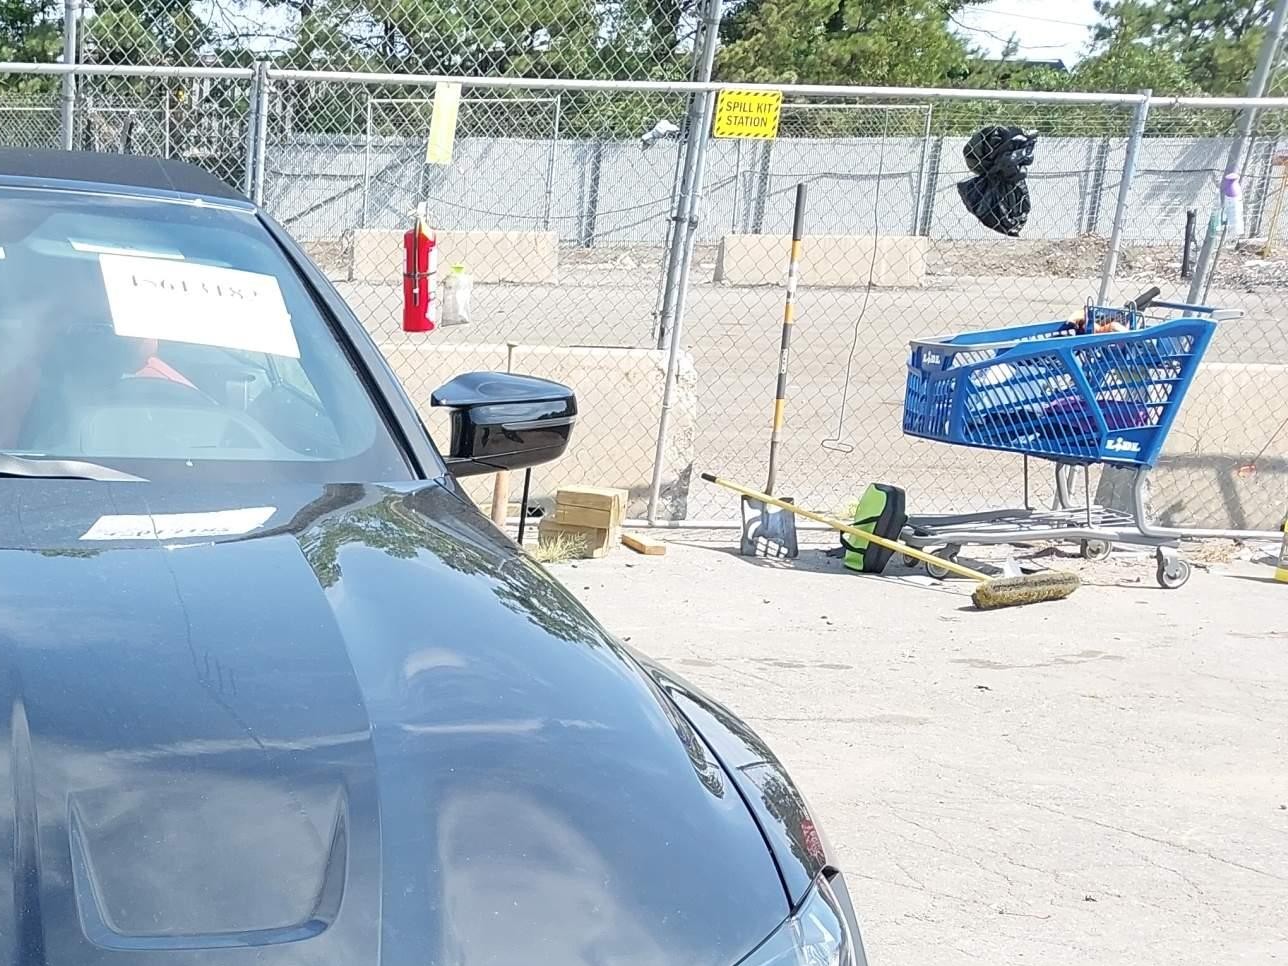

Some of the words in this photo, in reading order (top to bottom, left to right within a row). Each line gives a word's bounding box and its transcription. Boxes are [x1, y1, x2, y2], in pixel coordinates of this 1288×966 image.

[725, 101, 754, 113] SPILL
[756, 102, 774, 114] KIT
[726, 114, 768, 127] STATION
